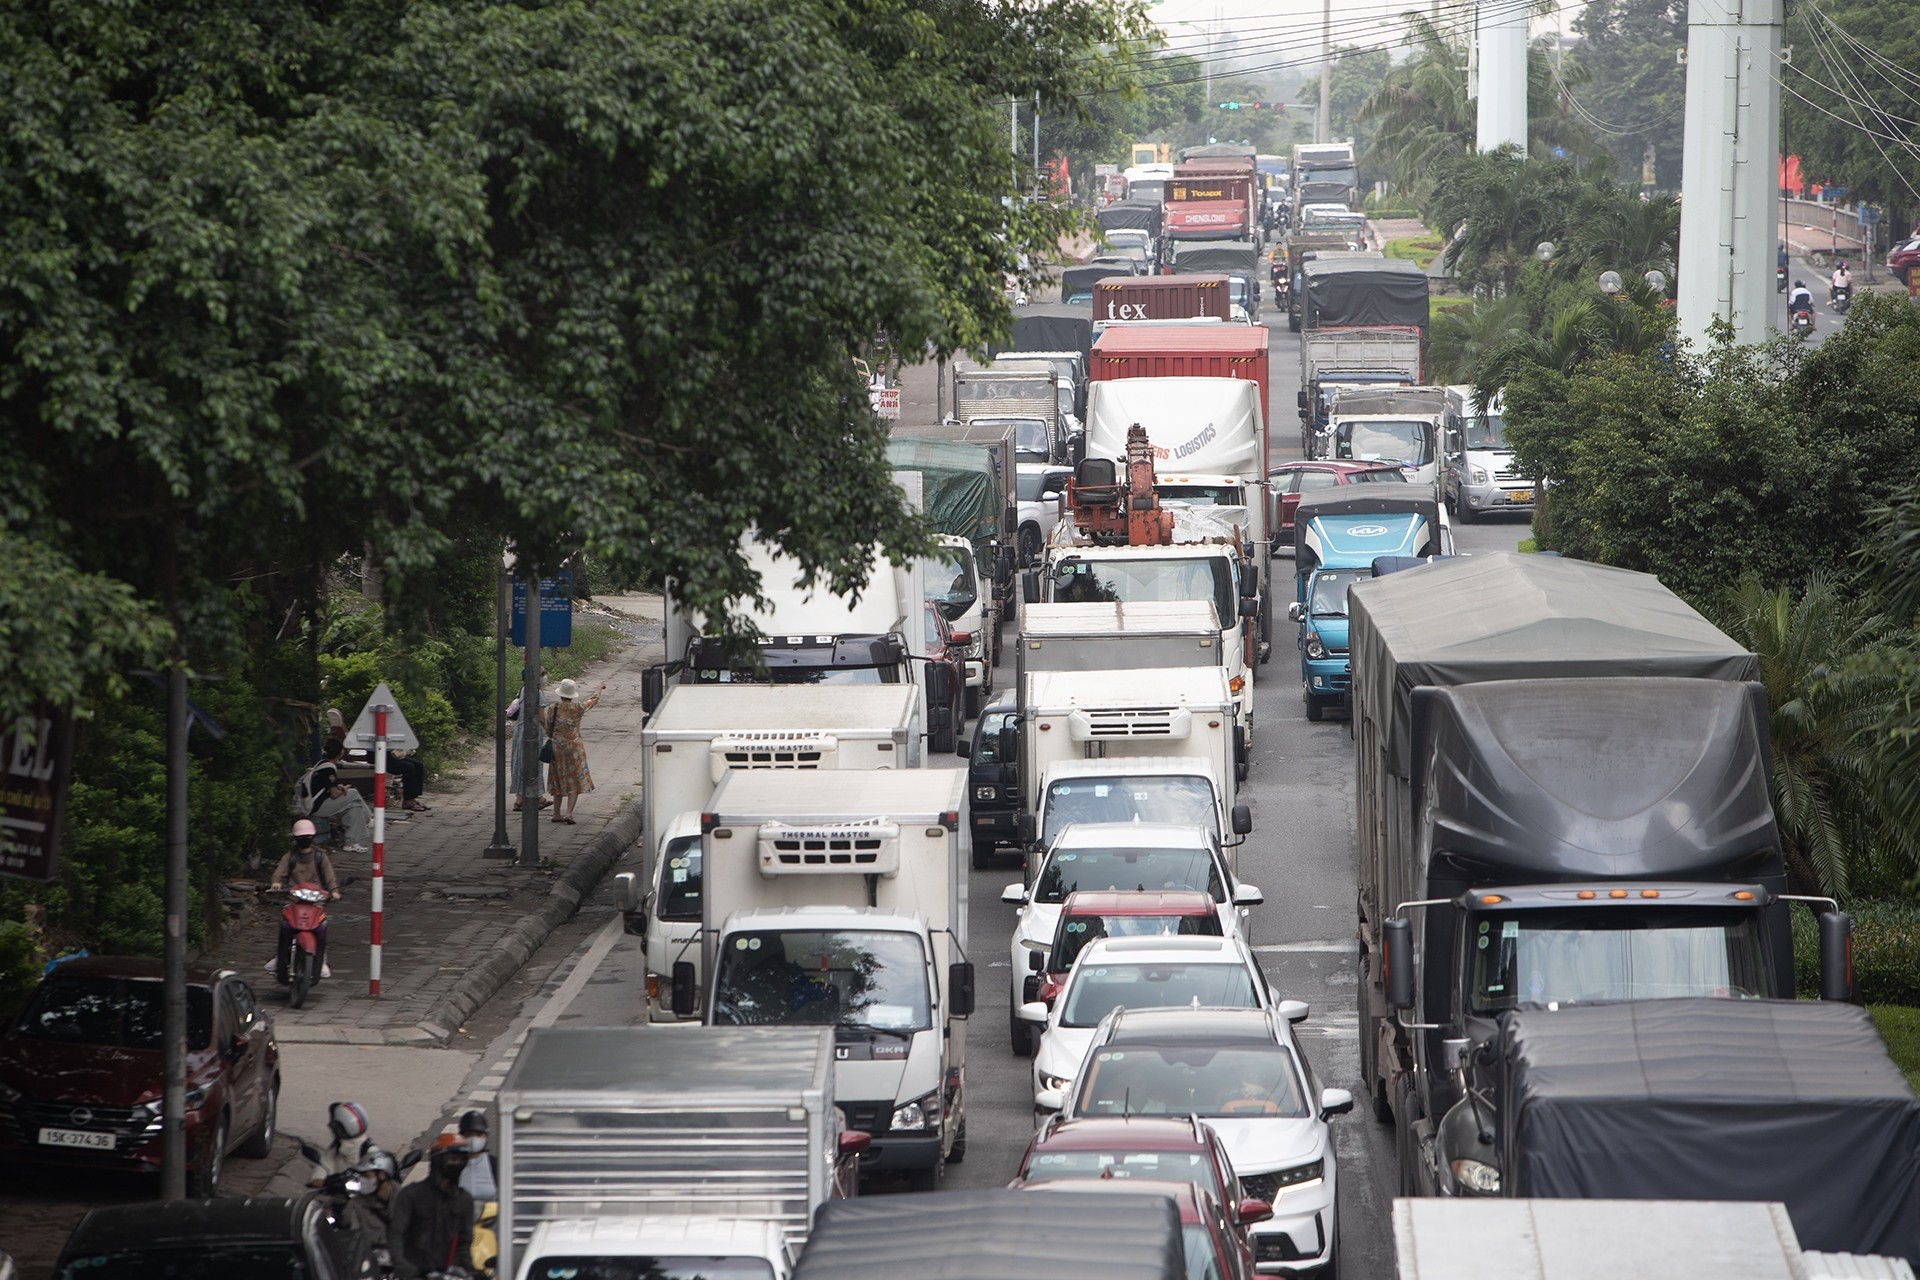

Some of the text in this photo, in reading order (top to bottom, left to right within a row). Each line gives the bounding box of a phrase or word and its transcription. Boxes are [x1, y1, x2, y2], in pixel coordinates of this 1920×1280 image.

[1185, 214, 1226, 223] CHENGLONG
[1107, 299, 1148, 319] tex
[1173, 422, 1217, 459] LOGISTICS
[0, 717, 55, 782] EL
